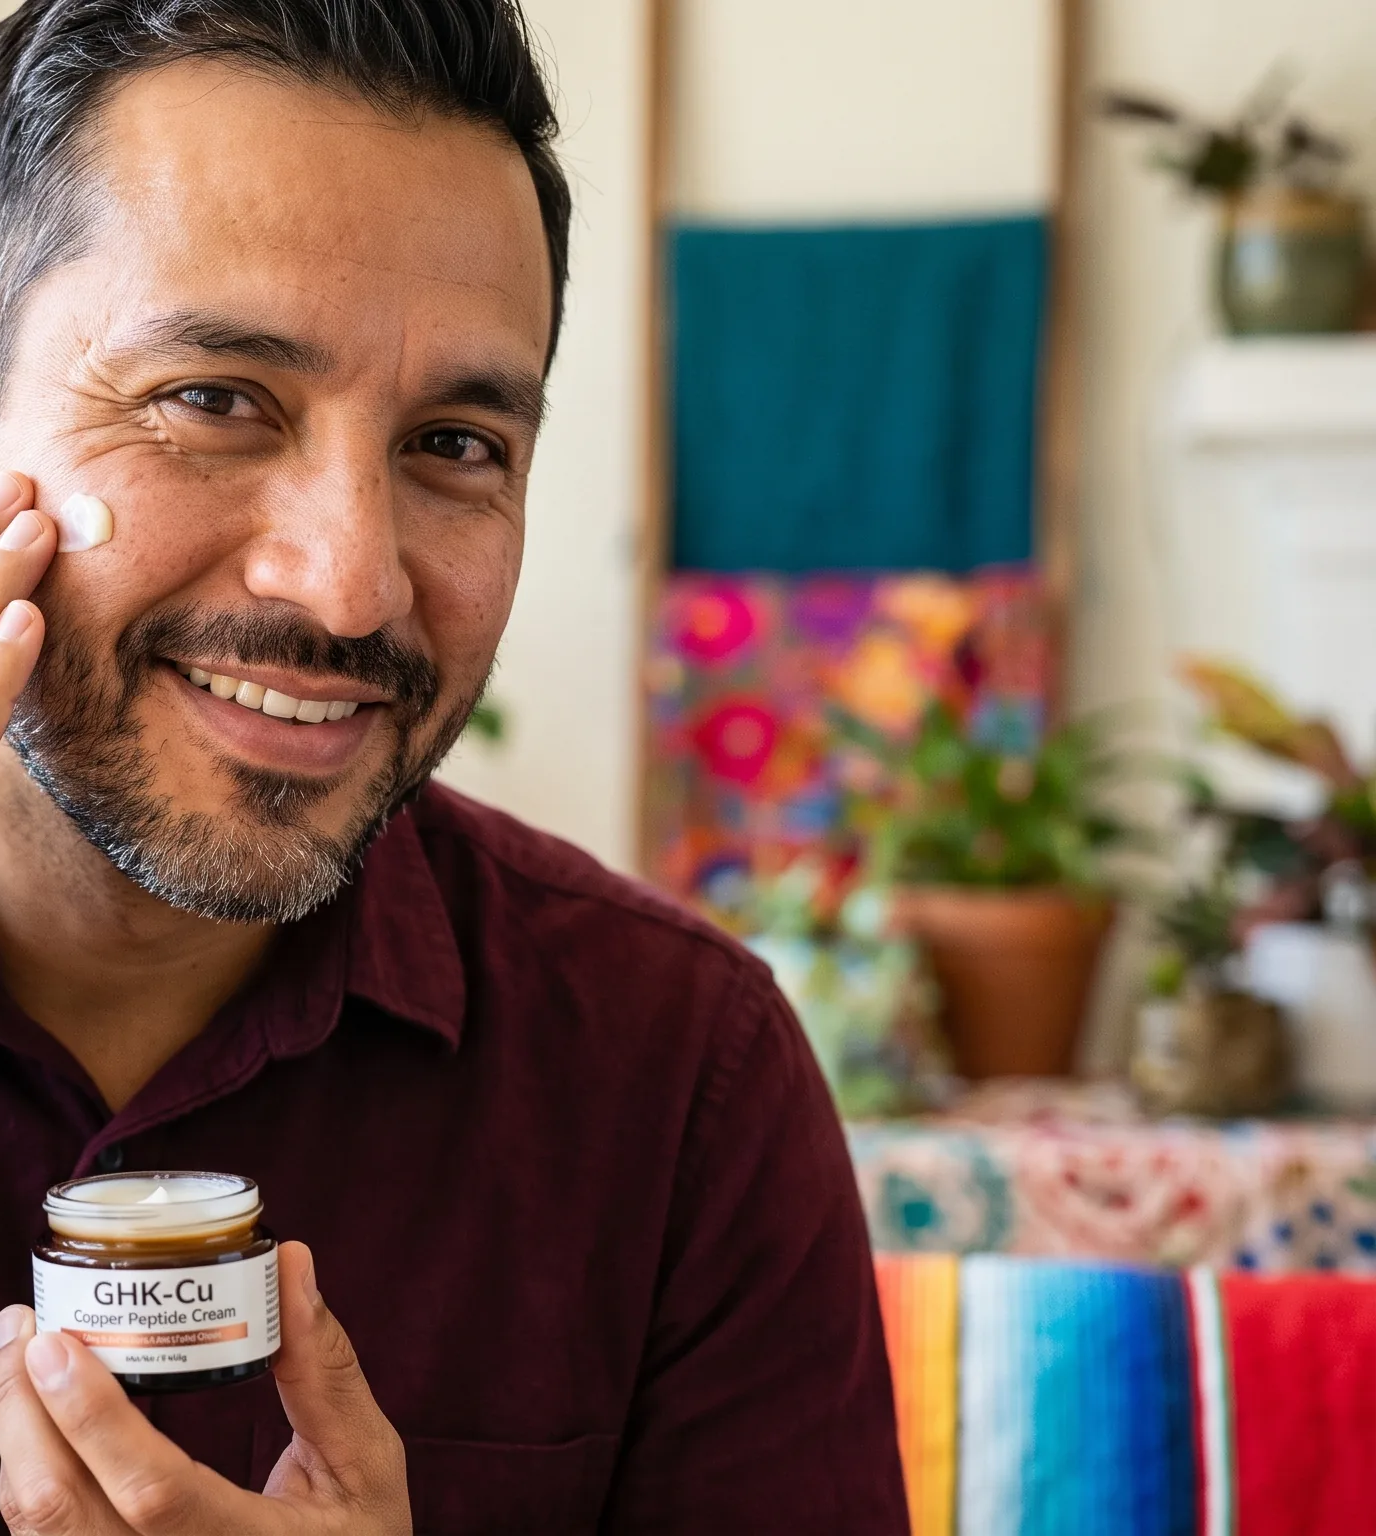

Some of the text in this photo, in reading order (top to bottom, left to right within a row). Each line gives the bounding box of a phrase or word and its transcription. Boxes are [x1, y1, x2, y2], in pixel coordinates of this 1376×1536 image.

[94, 1279, 214, 1306] GHK-Cu
[74, 1306, 237, 1329] Copper Peptide Cream
